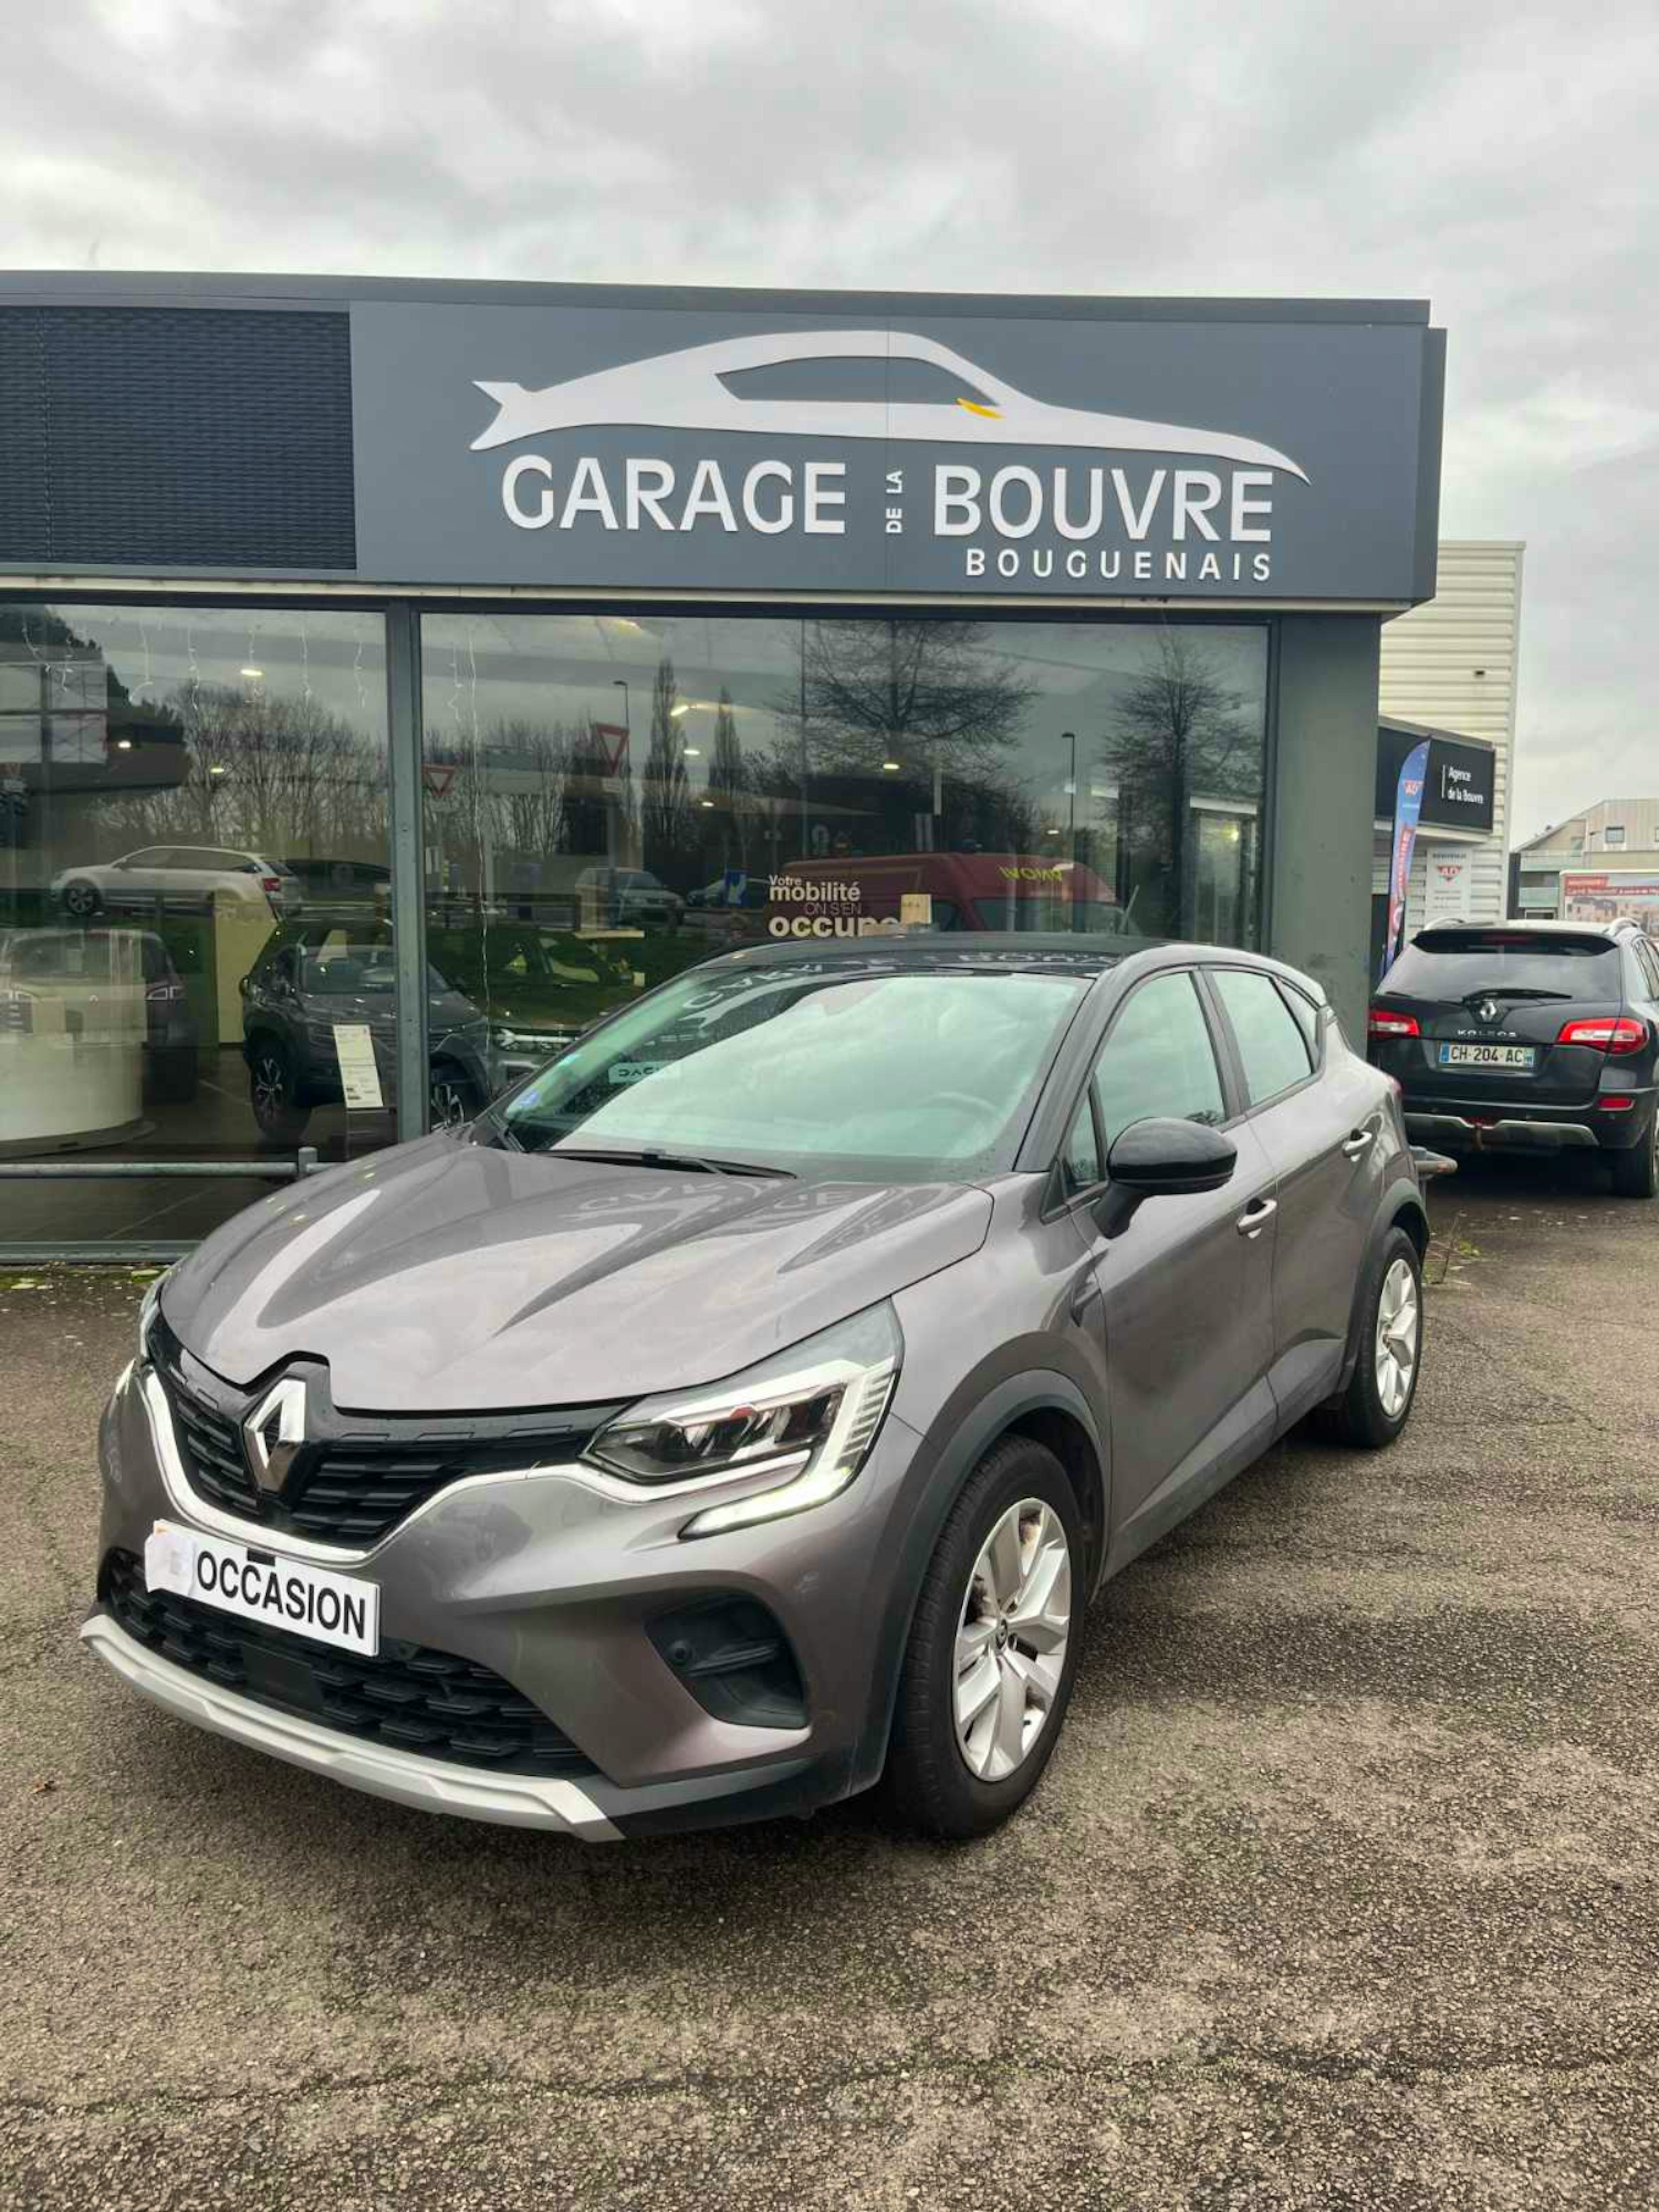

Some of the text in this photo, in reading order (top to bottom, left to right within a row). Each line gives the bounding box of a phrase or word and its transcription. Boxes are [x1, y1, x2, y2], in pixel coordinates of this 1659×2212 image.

[502, 454, 845, 534] GARAGE
[885, 470, 903, 533] DE LA
[934, 465, 1273, 542] BOUVRE
[966, 548, 1271, 582] BOUGUENAIS
[1449, 766, 1471, 782] Agence
[1448, 786, 1455, 800] de
[769, 875, 801, 886] Votre
[769, 881, 861, 902] mobilité
[197, 1551, 365, 1639] OCCASION
